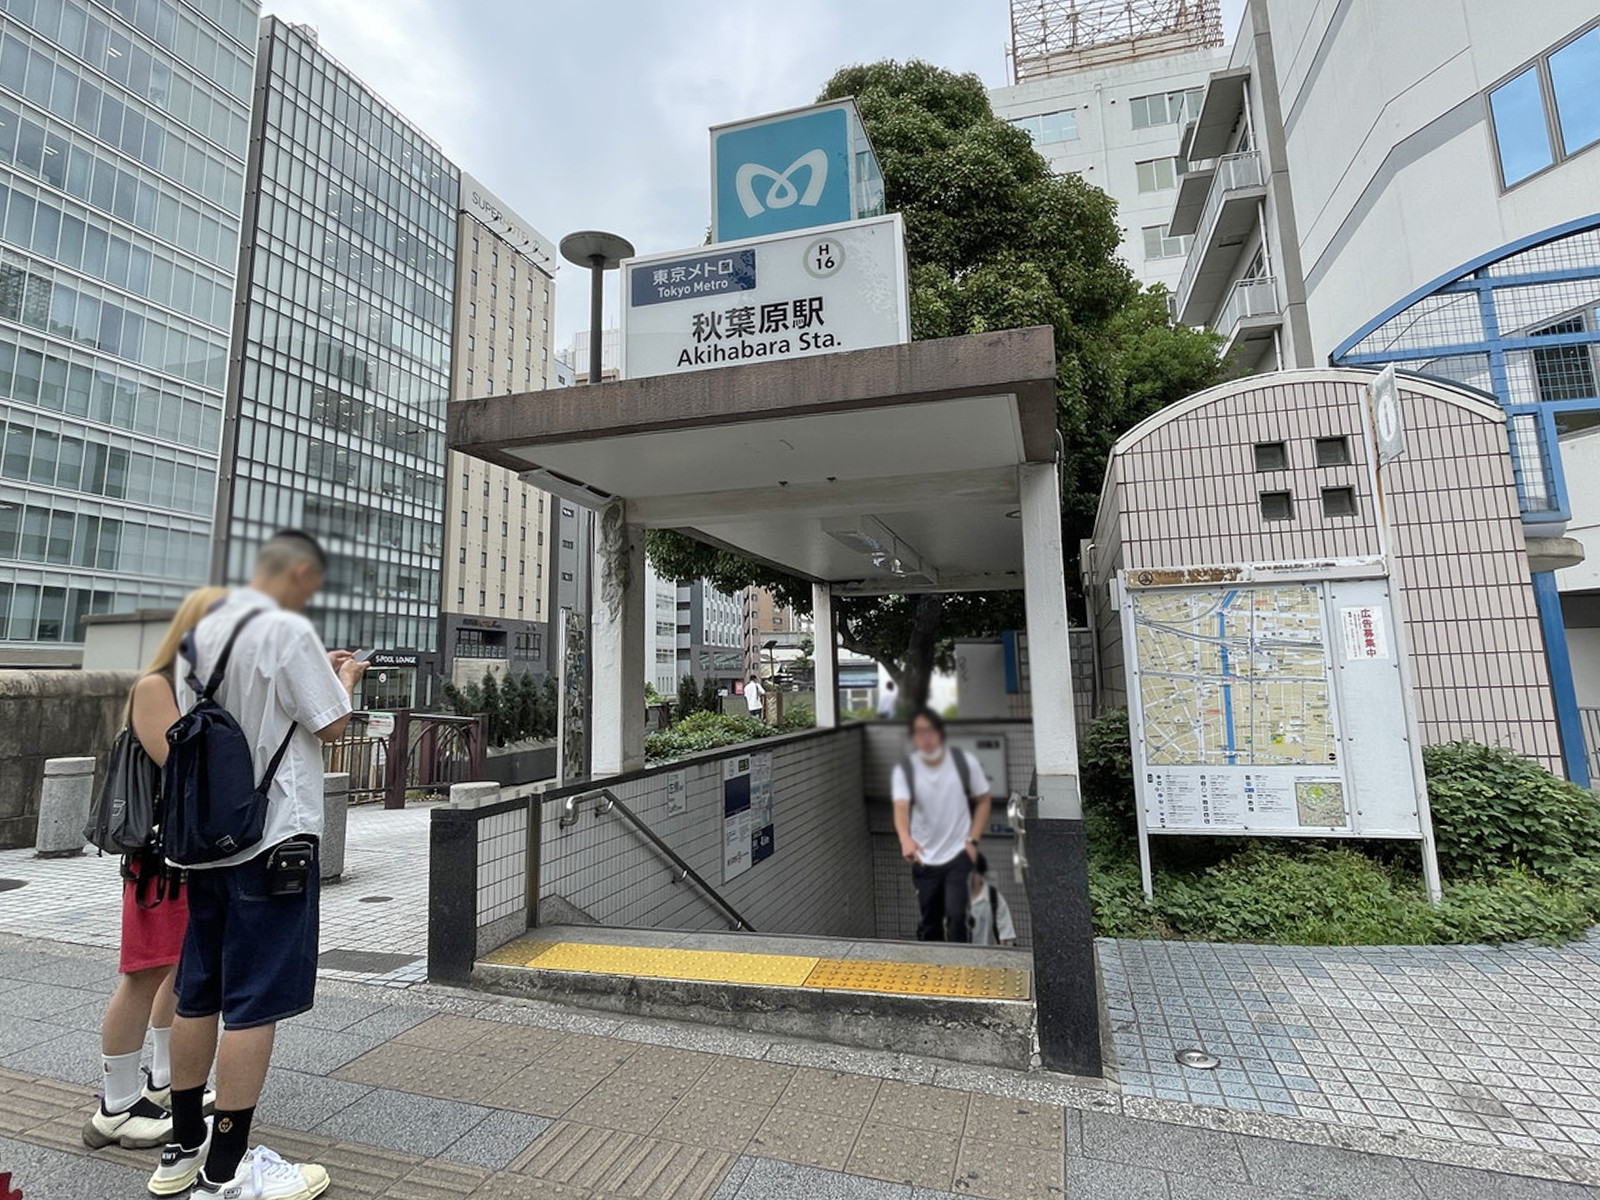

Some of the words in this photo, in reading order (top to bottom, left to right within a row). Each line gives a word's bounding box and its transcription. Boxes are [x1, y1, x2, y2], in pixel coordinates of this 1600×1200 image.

[471, 191, 503, 223] SUPER
[816, 256, 835, 270] 16
[819, 244, 829, 255] H
[653, 259, 733, 286] 東京メトロ
[657, 284, 691, 298] Tokyo
[694, 278, 728, 292] Metro
[692, 296, 824, 343] 秋葉原駅
[677, 337, 790, 367] Akihabara
[799, 331, 842, 351] Sta.
